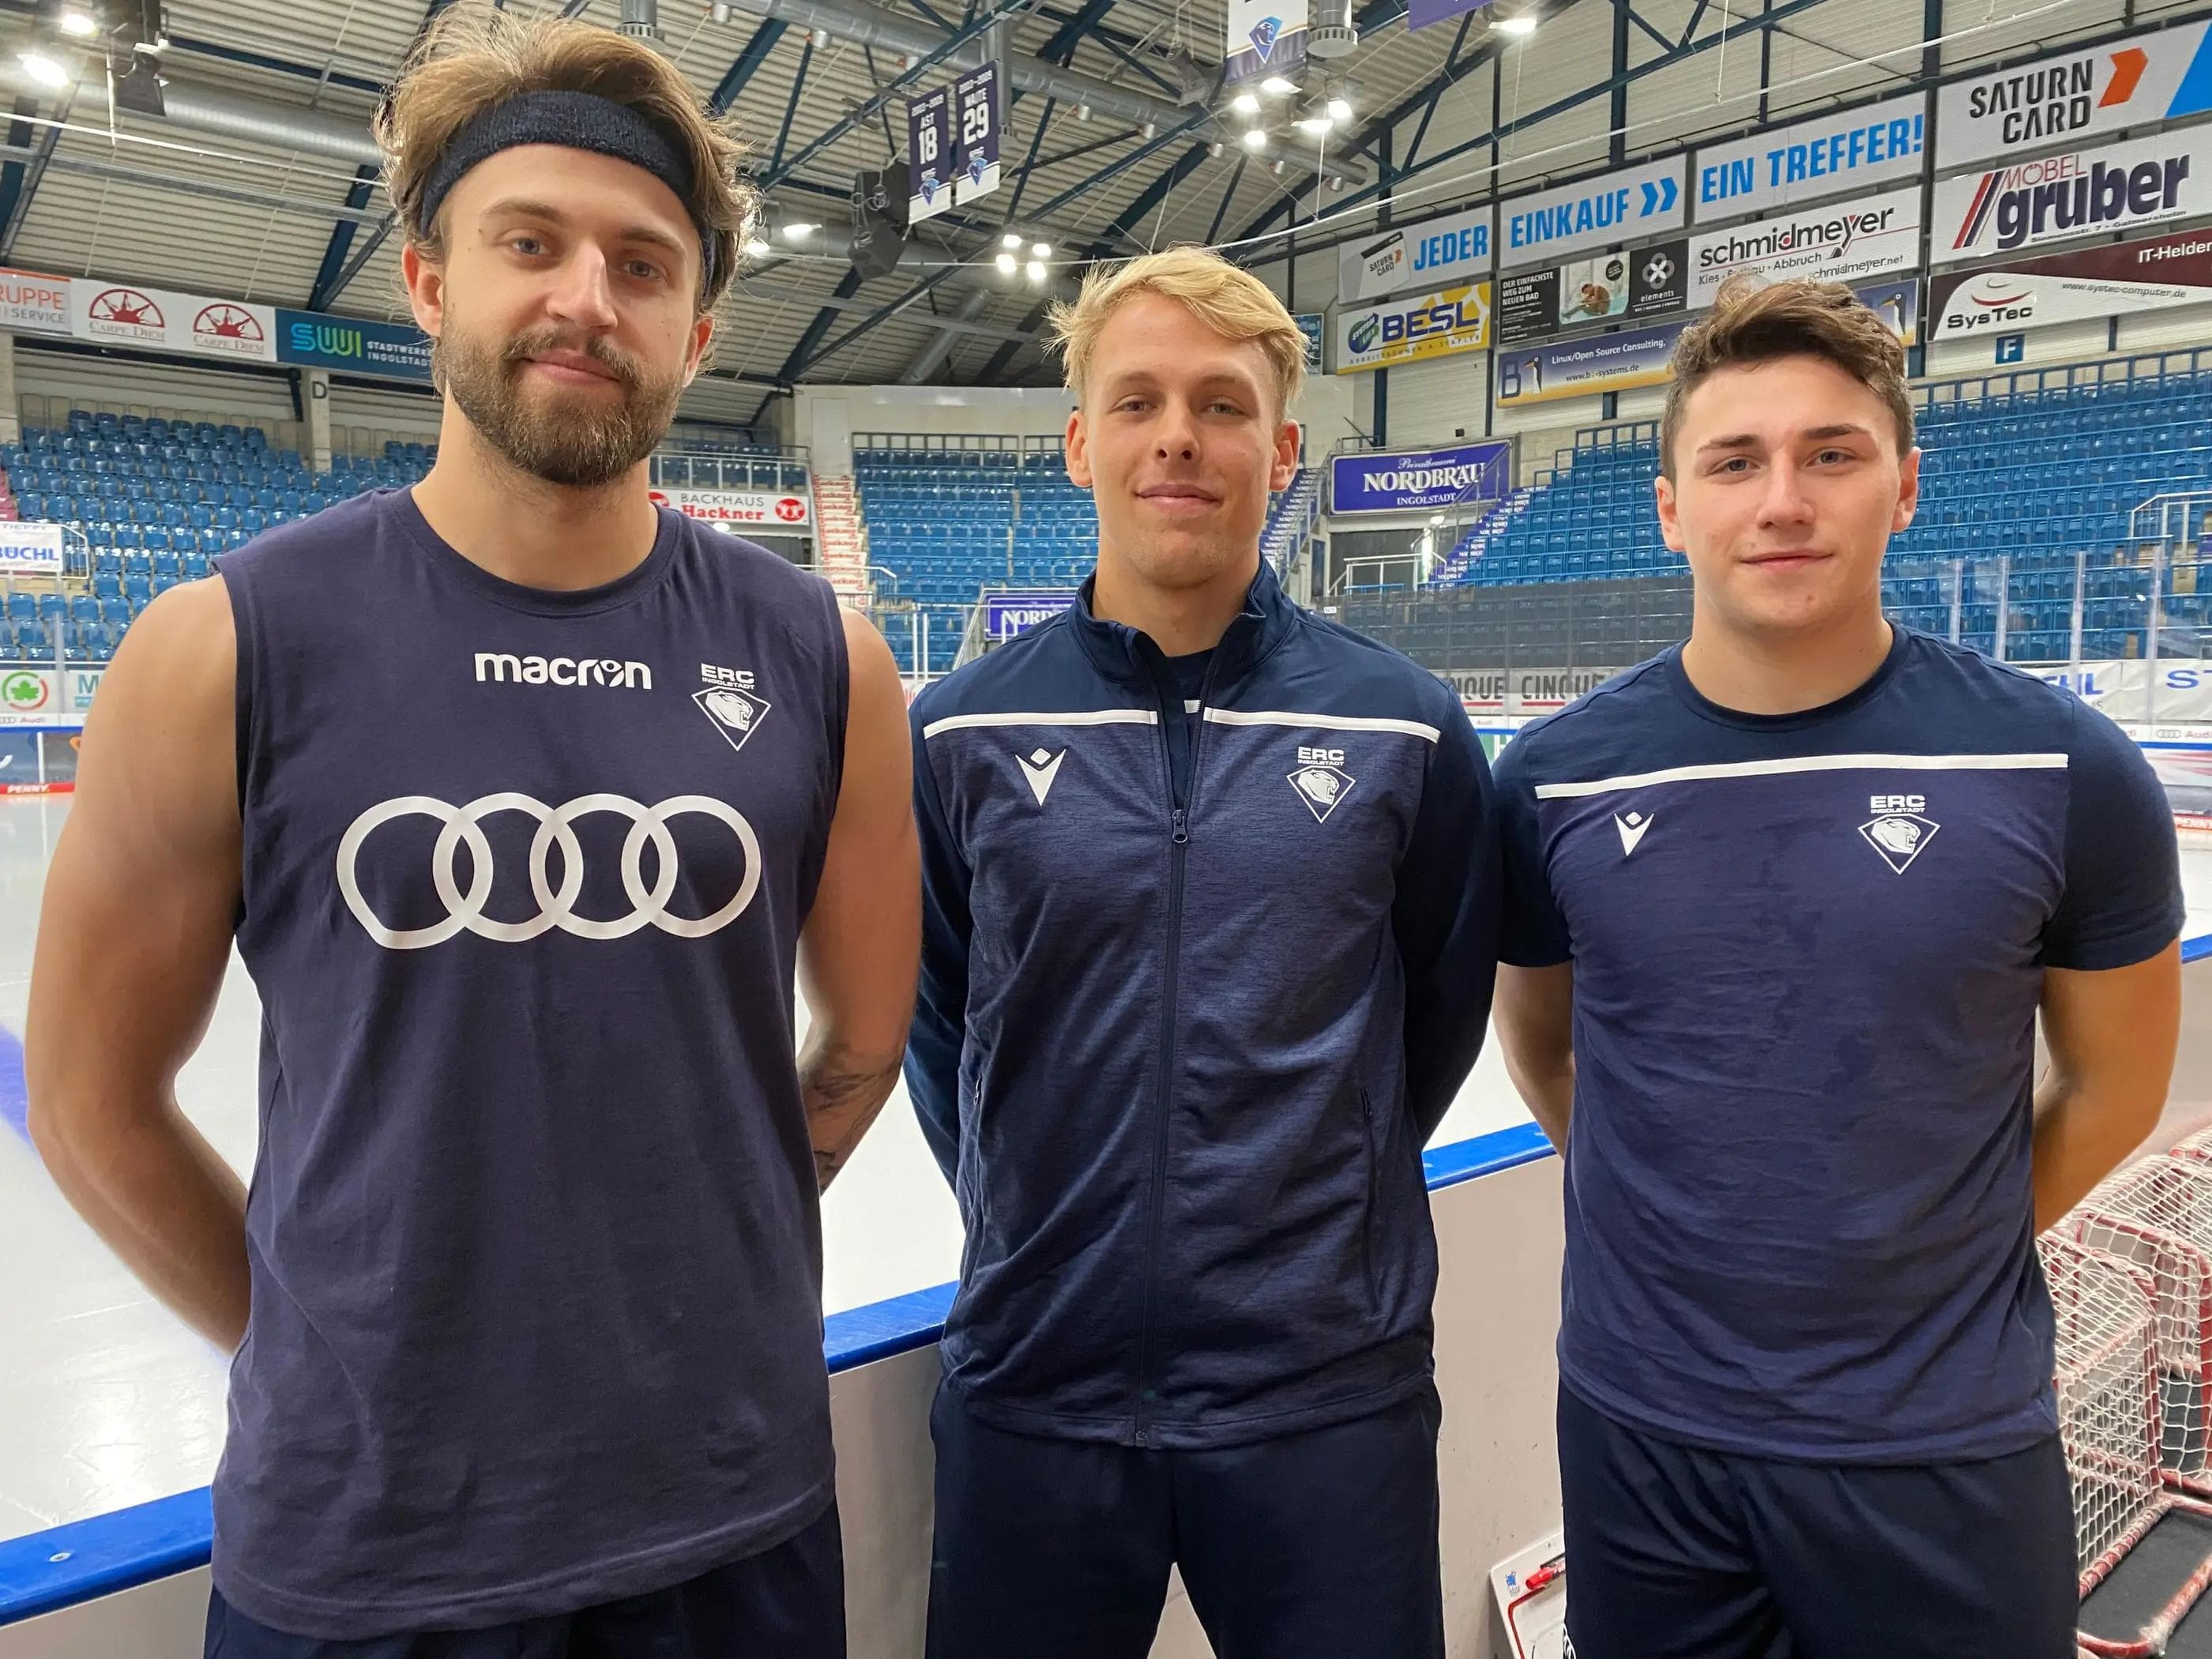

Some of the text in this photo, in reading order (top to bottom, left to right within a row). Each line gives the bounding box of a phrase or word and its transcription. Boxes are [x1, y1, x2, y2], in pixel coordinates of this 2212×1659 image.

[1969, 58, 2094, 118] SATURN
[962, 102, 990, 145] 29
[2003, 95, 2092, 144] CARD
[918, 126, 938, 164] 18
[1701, 114, 1924, 203] EIN TREFFER!
[2003, 154, 2088, 190] MÖBEL
[1997, 154, 2191, 249] gruber
[1510, 188, 1630, 248] EINKAUF
[1413, 224, 1488, 271] JEDER
[1699, 207, 1894, 268] schmidmeyer
[1698, 273, 1720, 285] Kies
[1774, 252, 1822, 270] Abbruch
[1503, 271, 1554, 289] DER EINFACHSTE
[1503, 284, 1533, 297] WEG ZUM
[2061, 281, 2187, 299] www.systec-computer.de
[1502, 292, 1540, 306] NEUEN BAD
[1640, 289, 1675, 303] elements
[11, 308, 65, 323] SERVICE
[1382, 301, 1480, 343] BESL
[1947, 306, 2033, 329] SysTec
[291, 322, 362, 357] SWI
[2003, 339, 2017, 359] F
[1552, 350, 1594, 364] Linux/Open
[1596, 347, 1621, 357] Source
[312, 381, 328, 399] D
[1363, 462, 1486, 494] NORDBRÄU
[681, 493, 765, 507] BACKHAUS
[1397, 492, 1457, 506] INGOLSTADT
[682, 505, 766, 521] Hackner
[474, 652, 652, 690] macron
[701, 663, 754, 684] ERC
[702, 677, 755, 690] INGOLSTADT
[1298, 746, 1345, 761] ERC
[1870, 795, 1926, 809] ERC
